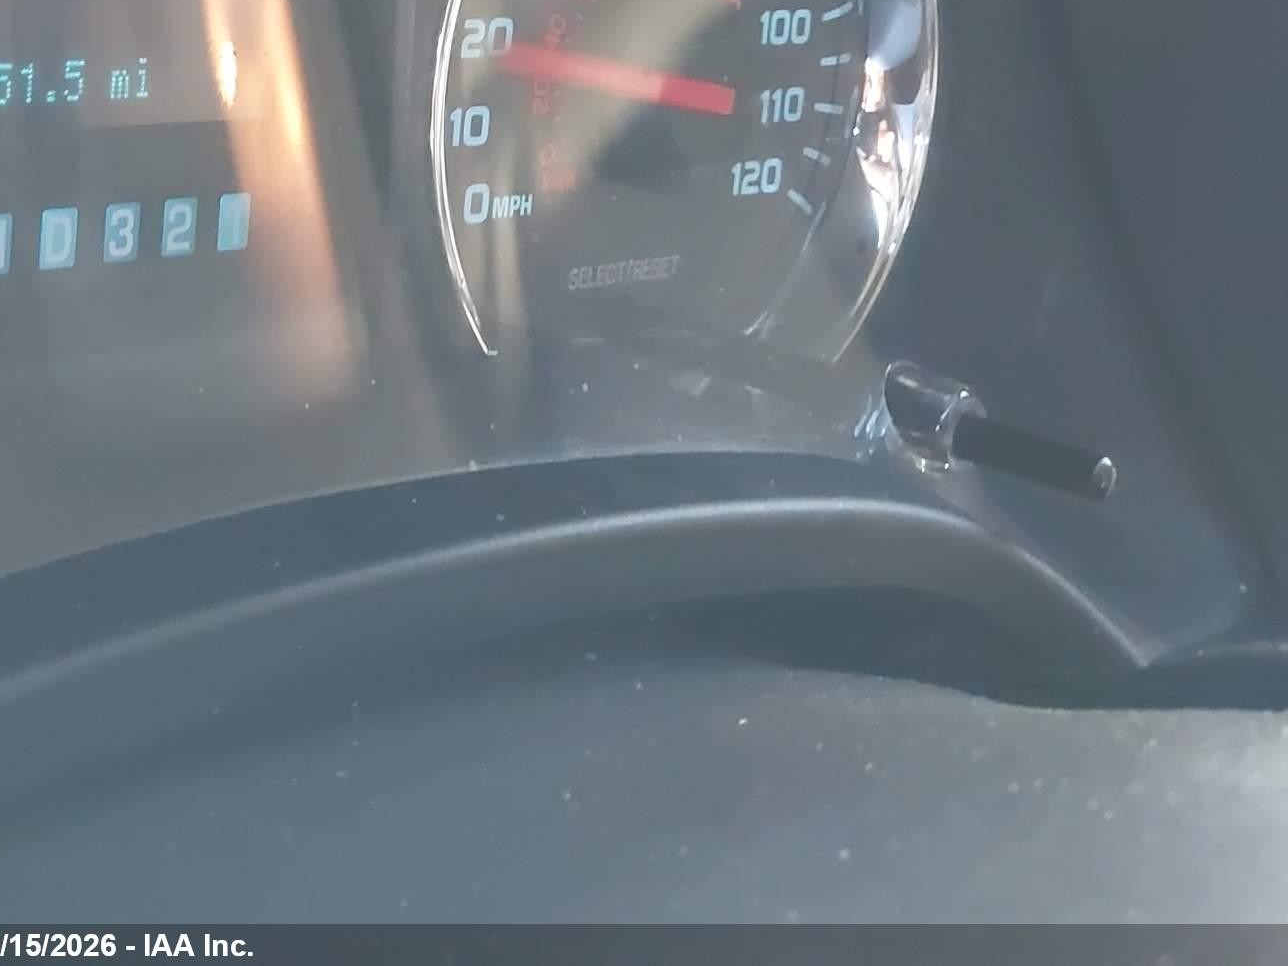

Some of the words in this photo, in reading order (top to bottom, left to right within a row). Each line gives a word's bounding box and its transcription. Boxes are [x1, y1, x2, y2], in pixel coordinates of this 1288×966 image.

[460, 17, 514, 60] 20
[760, 8, 813, 47] 100
[109, 57, 150, 100] mi
[449, 105, 491, 148] 10
[759, 87, 805, 124] 110
[730, 157, 783, 196] 120
[463, 182, 491, 225] 0
[492, 193, 533, 219] MPH
[44, 216, 74, 262] D
[107, 209, 135, 258] 3
[166, 204, 194, 251] 2
[568, 255, 680, 290] SELECT/RESET
